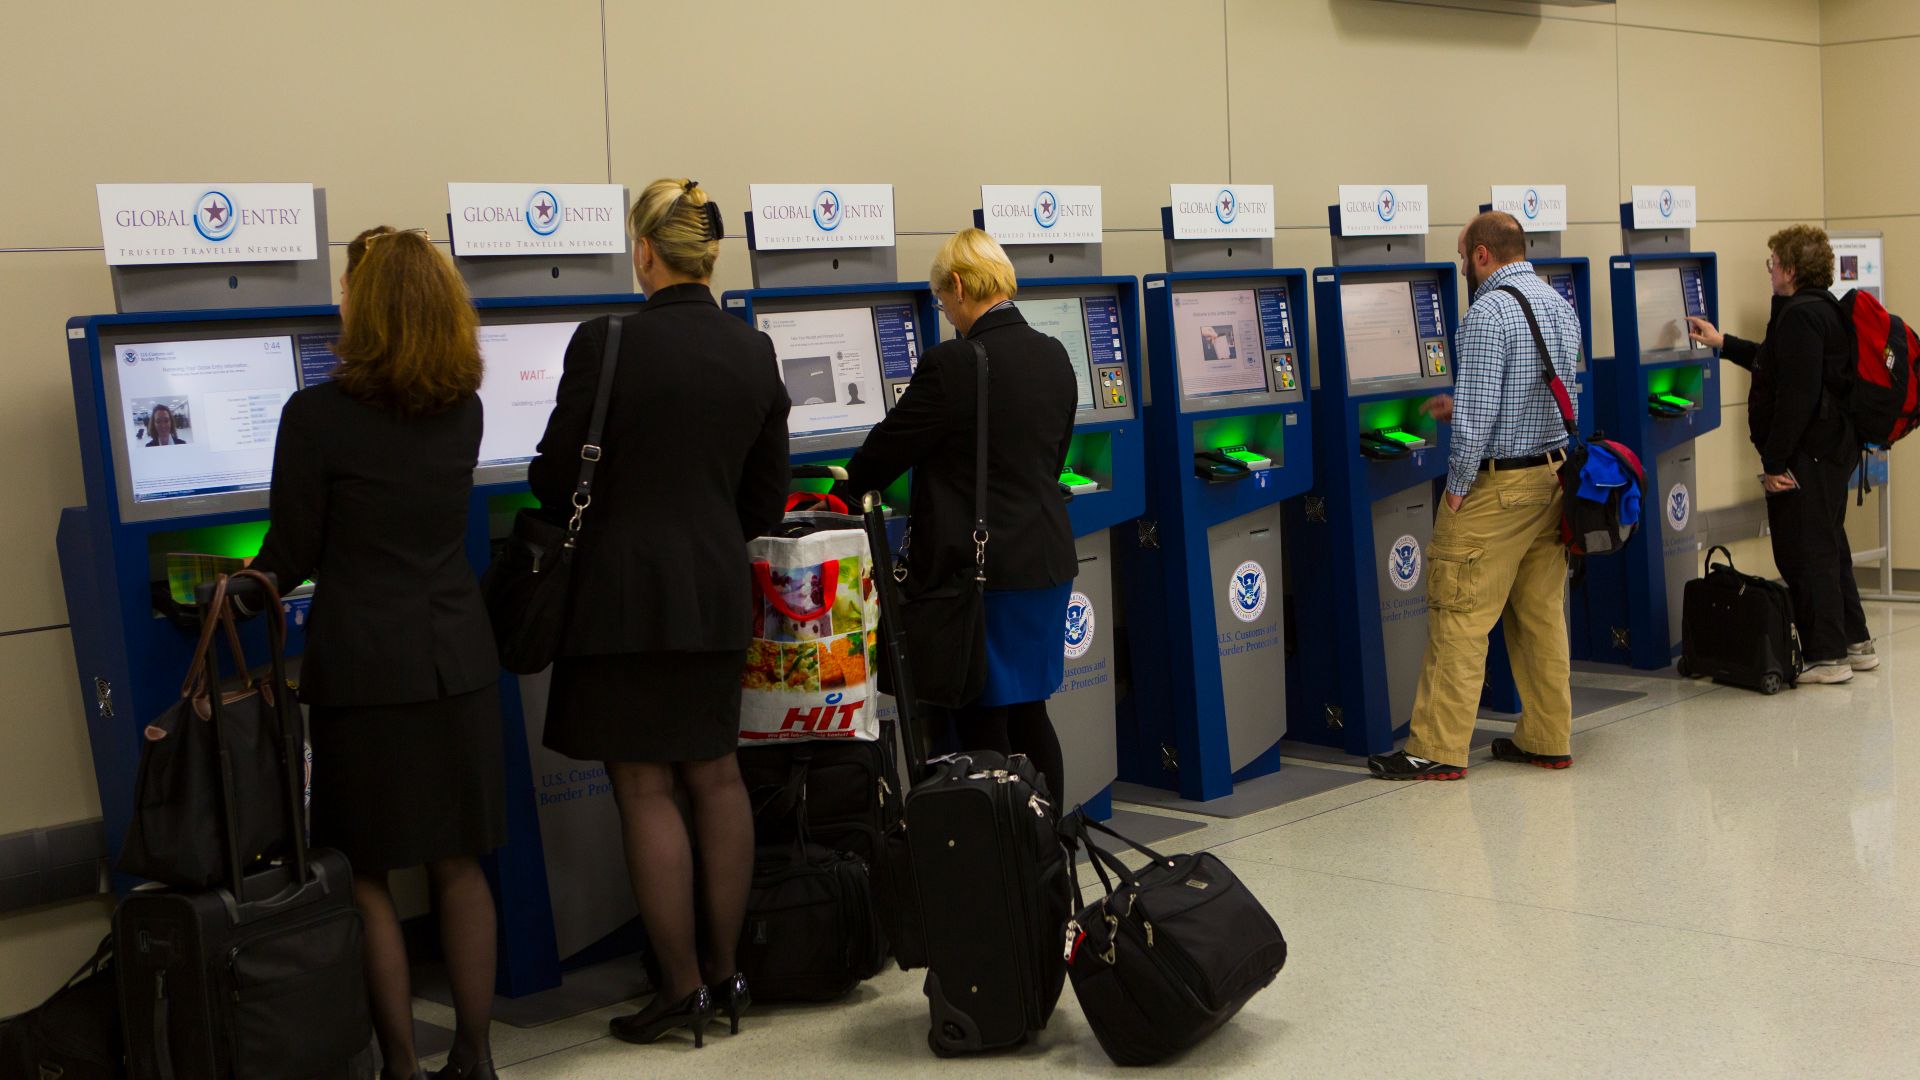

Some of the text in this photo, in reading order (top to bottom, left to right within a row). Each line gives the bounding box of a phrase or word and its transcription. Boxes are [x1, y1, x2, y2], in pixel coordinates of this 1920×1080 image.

[463, 206, 613, 222] GLOBAL ENTRY
[762, 204, 884, 220] GLOBAL ENTRY
[991, 204, 1094, 217] GLOBAL ENTRY
[1179, 202, 1267, 214] GLOBAL ENTRY
[1346, 201, 1422, 213] GLOBAL ENTRY
[116, 208, 302, 227] GLOBAL ENTRY
[120, 245, 302, 257] TRUSTED TRAVELER NETWORK
[263, 341, 281, 351] 0:44
[1382, 611, 1402, 623] order
[1234, 626, 1266, 641] Customs
[1063, 657, 1106, 678] ustoms and
[1071, 673, 1108, 690] Protection
[780, 700, 866, 731] HIT
[542, 767, 609, 787] U.S. Custo
[540, 787, 584, 806] Border
